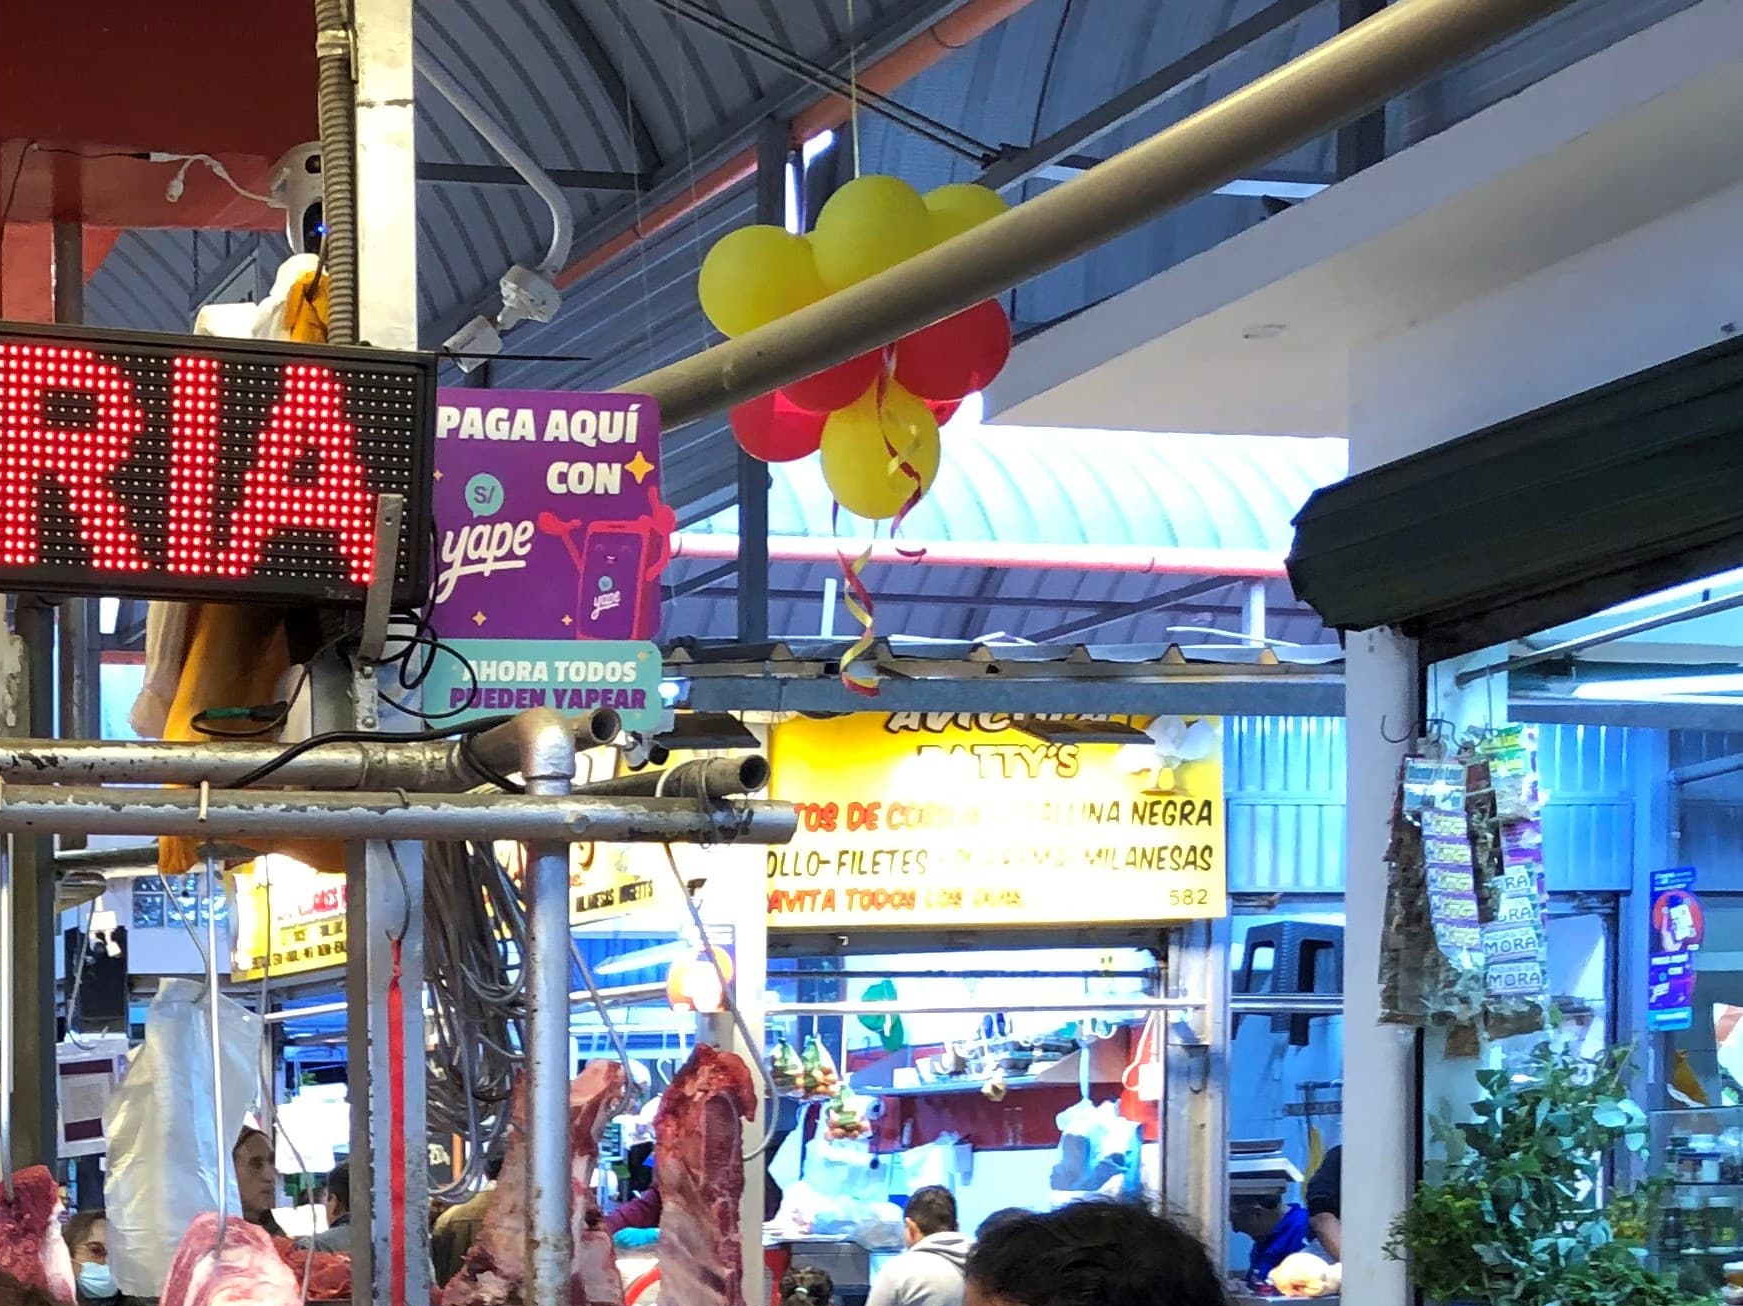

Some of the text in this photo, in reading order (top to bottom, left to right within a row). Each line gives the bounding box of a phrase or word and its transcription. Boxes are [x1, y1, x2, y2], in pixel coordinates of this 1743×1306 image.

[436, 404, 641, 446] PAGA AQUÍ
[546, 462, 621, 495] CON
[430, 520, 535, 604] yape
[590, 590, 621, 620] yape
[461, 661, 636, 683] AHORA TODOS
[450, 687, 646, 710] PUEDEN YAPEAR
[846, 801, 882, 833] DE
[1131, 799, 1213, 827] NEGRA
[767, 889, 836, 914] AVITA
[845, 887, 917, 911] TODOS
[1169, 888, 1209, 906] 582
[1483, 936, 1537, 956] MORA
[1488, 972, 1541, 988] MORA
